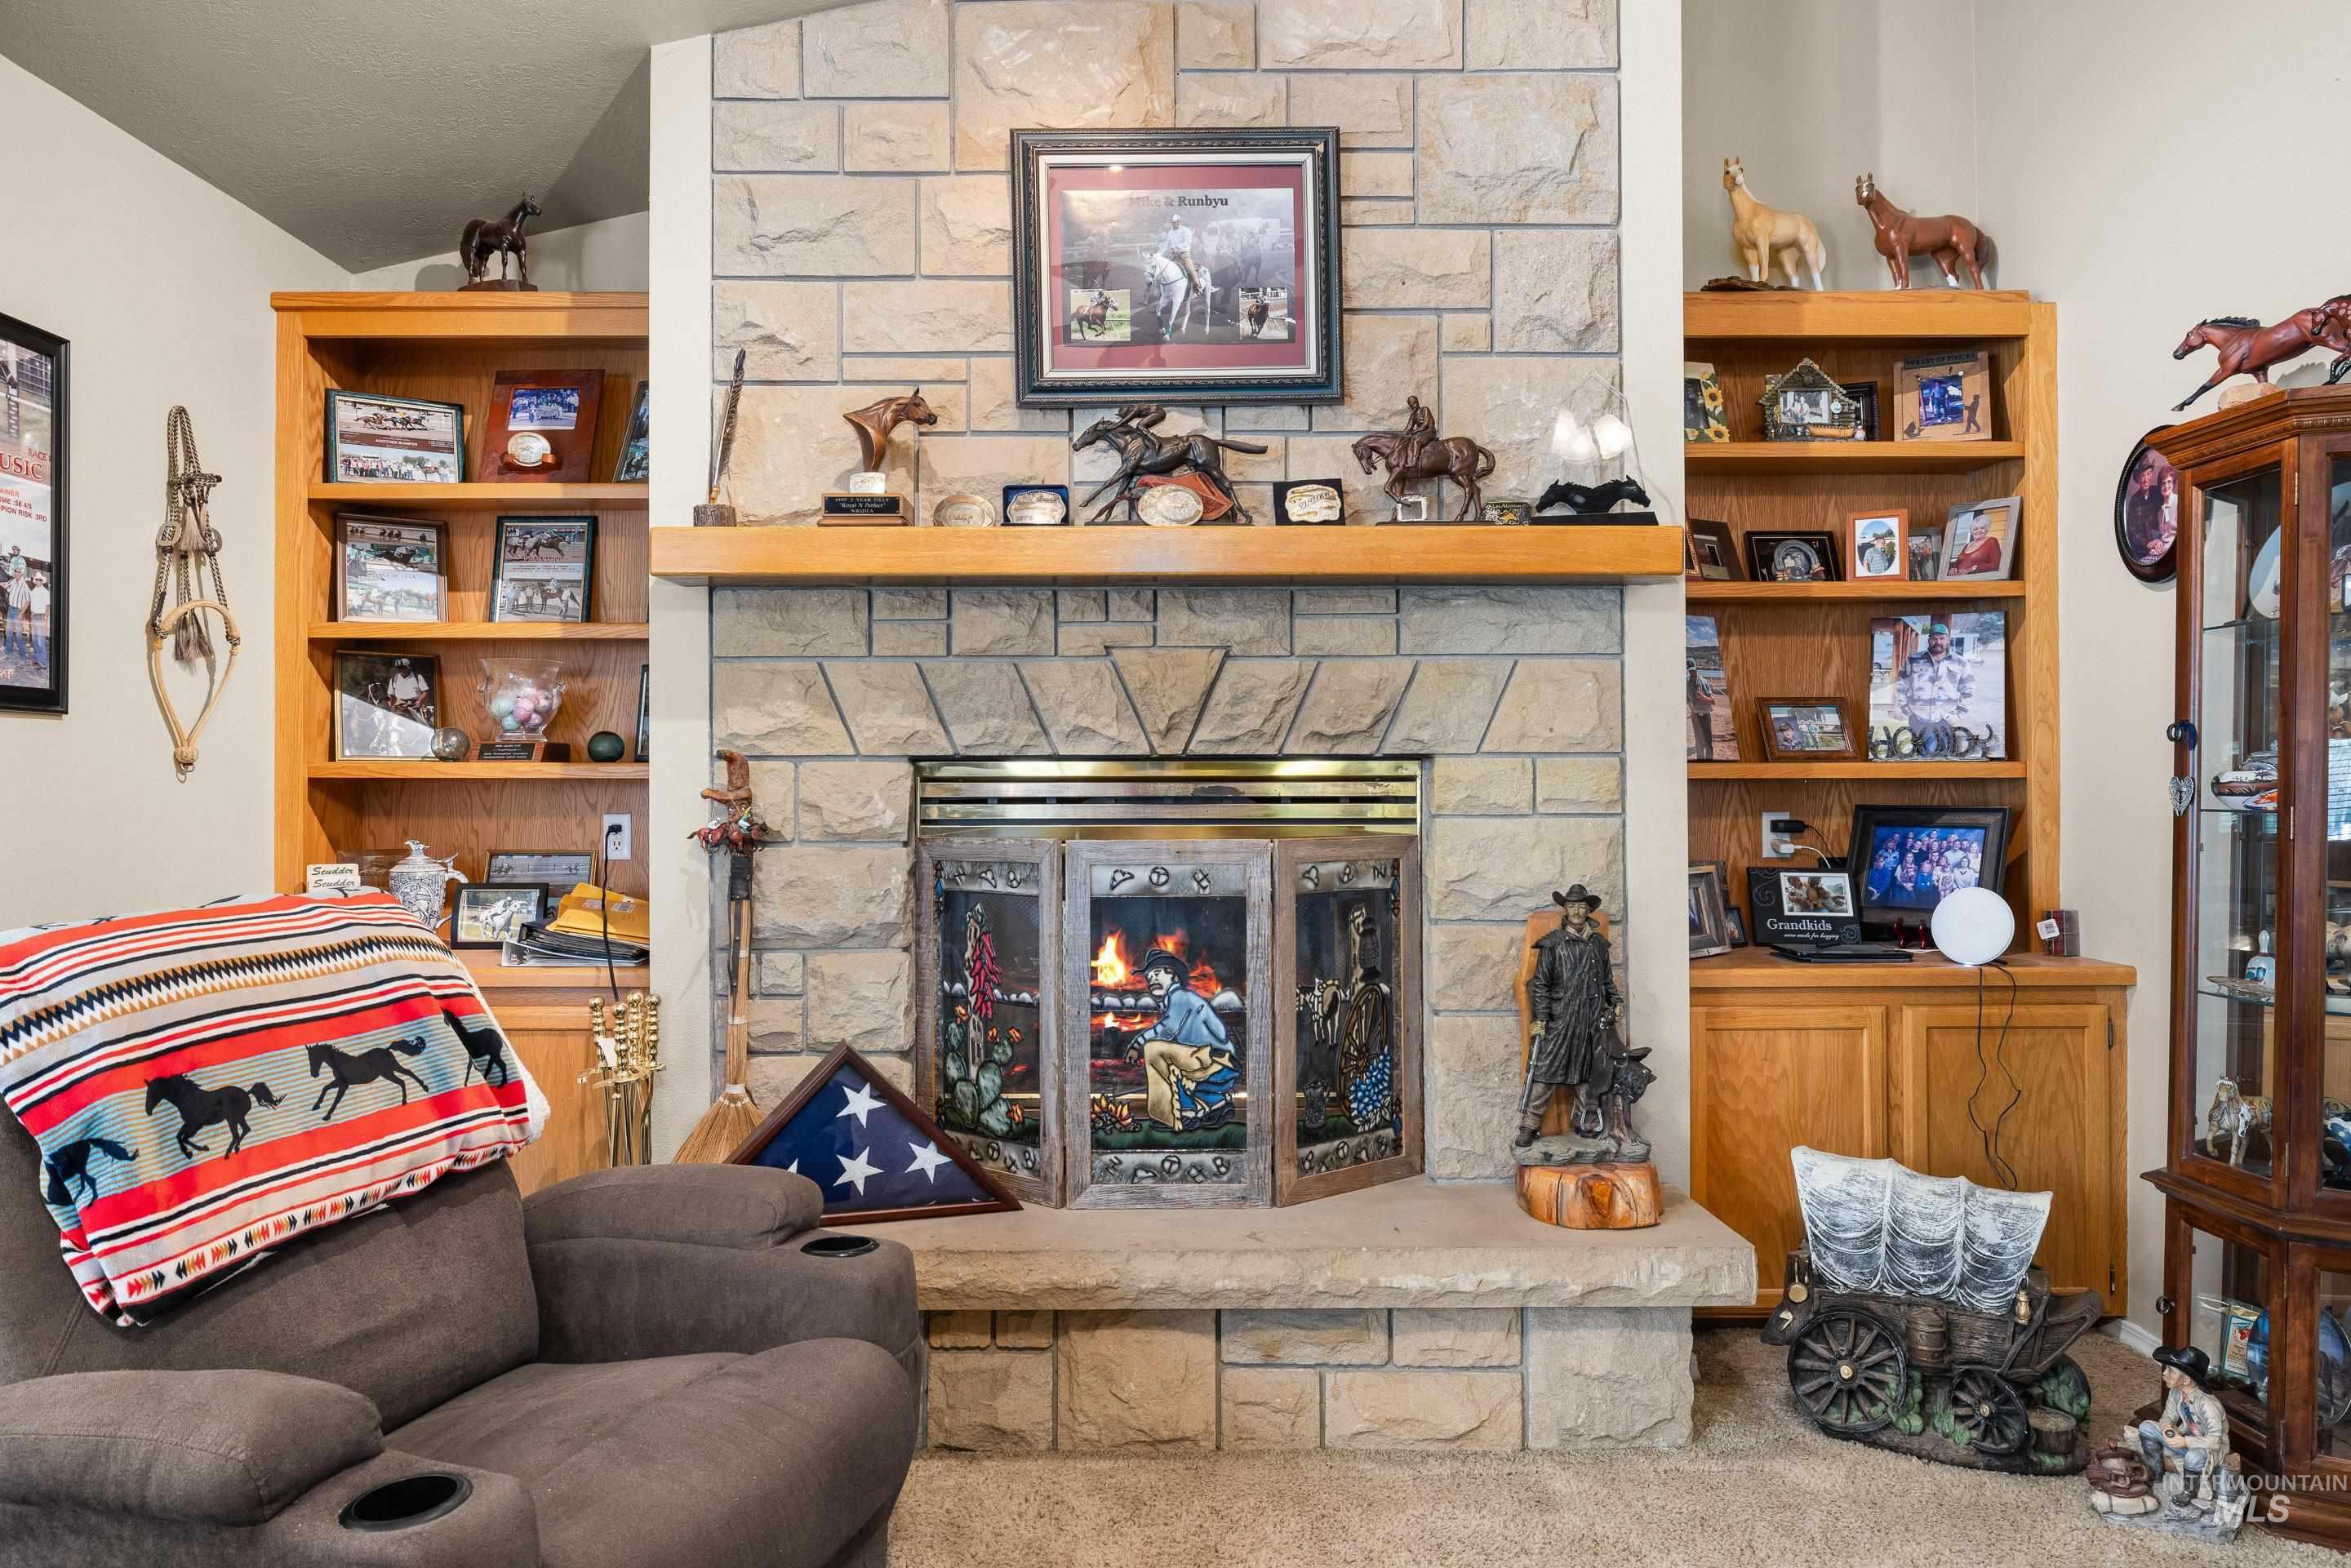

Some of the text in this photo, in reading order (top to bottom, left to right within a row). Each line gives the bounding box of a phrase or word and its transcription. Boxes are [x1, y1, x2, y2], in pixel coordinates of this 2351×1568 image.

[1128, 194, 1229, 208] Mike & Runbyu
[18, 509, 33, 519] RISK
[35, 514, 47, 522] 3RD
[1767, 918, 1833, 931] Grandkids
